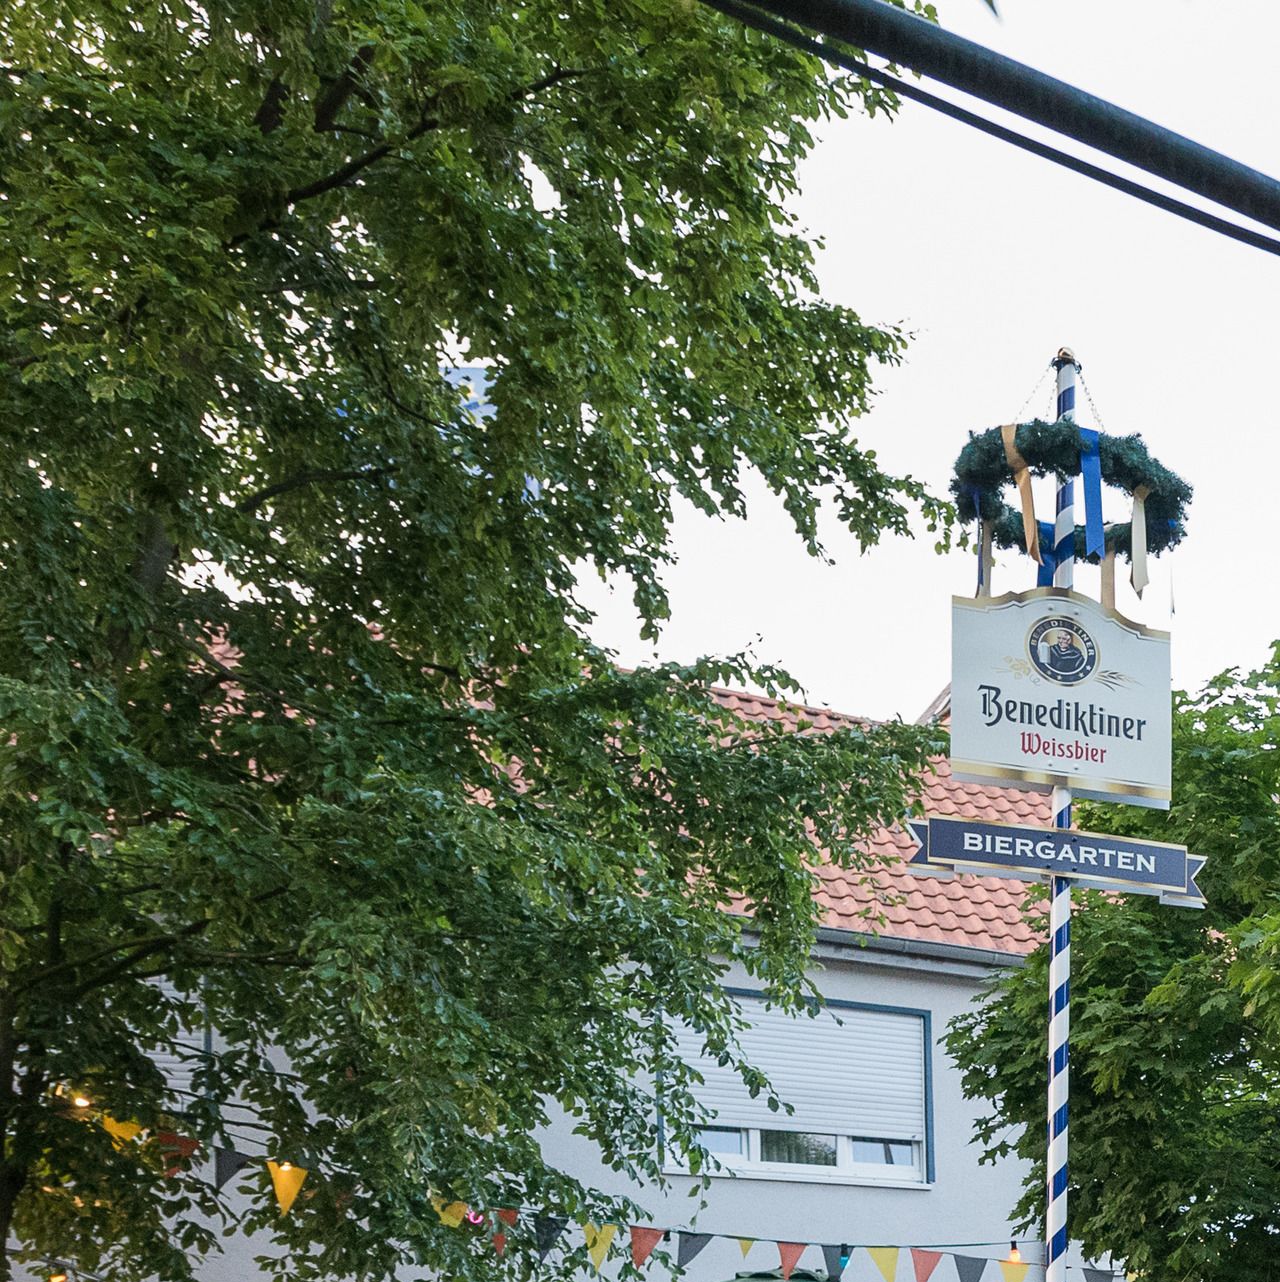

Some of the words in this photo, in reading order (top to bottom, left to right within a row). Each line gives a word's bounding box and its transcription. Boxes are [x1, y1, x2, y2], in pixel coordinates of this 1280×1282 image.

[1031, 620, 1095, 656] BENEDITINER
[978, 685, 1147, 741] Benediktiner
[1021, 731, 1107, 764] Weissbier
[963, 832, 1156, 873] BIERGARTEN
